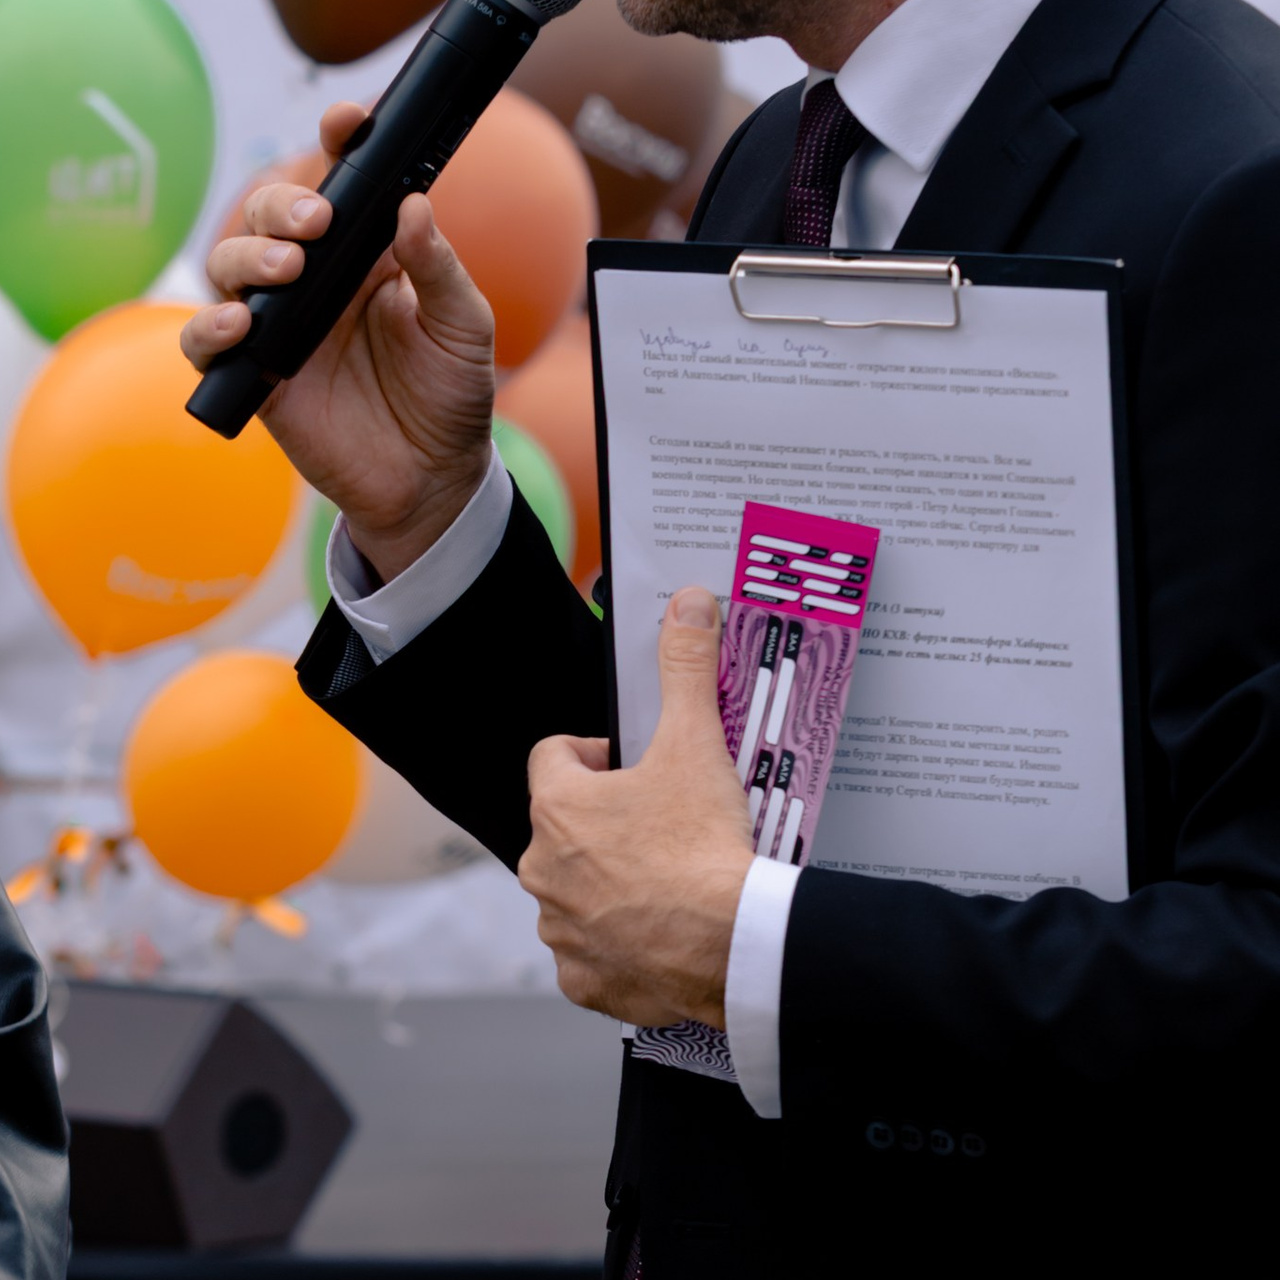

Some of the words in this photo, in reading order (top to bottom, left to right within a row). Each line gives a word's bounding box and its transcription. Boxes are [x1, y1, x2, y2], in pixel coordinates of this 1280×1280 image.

[477, 2, 493, 18] 58A
[764, 626, 778, 663] ФИЛЬМ
[787, 632, 799, 652] ЗАЛ
[756, 761, 769, 780] РЯД
[777, 757, 791, 783] ДАТА
